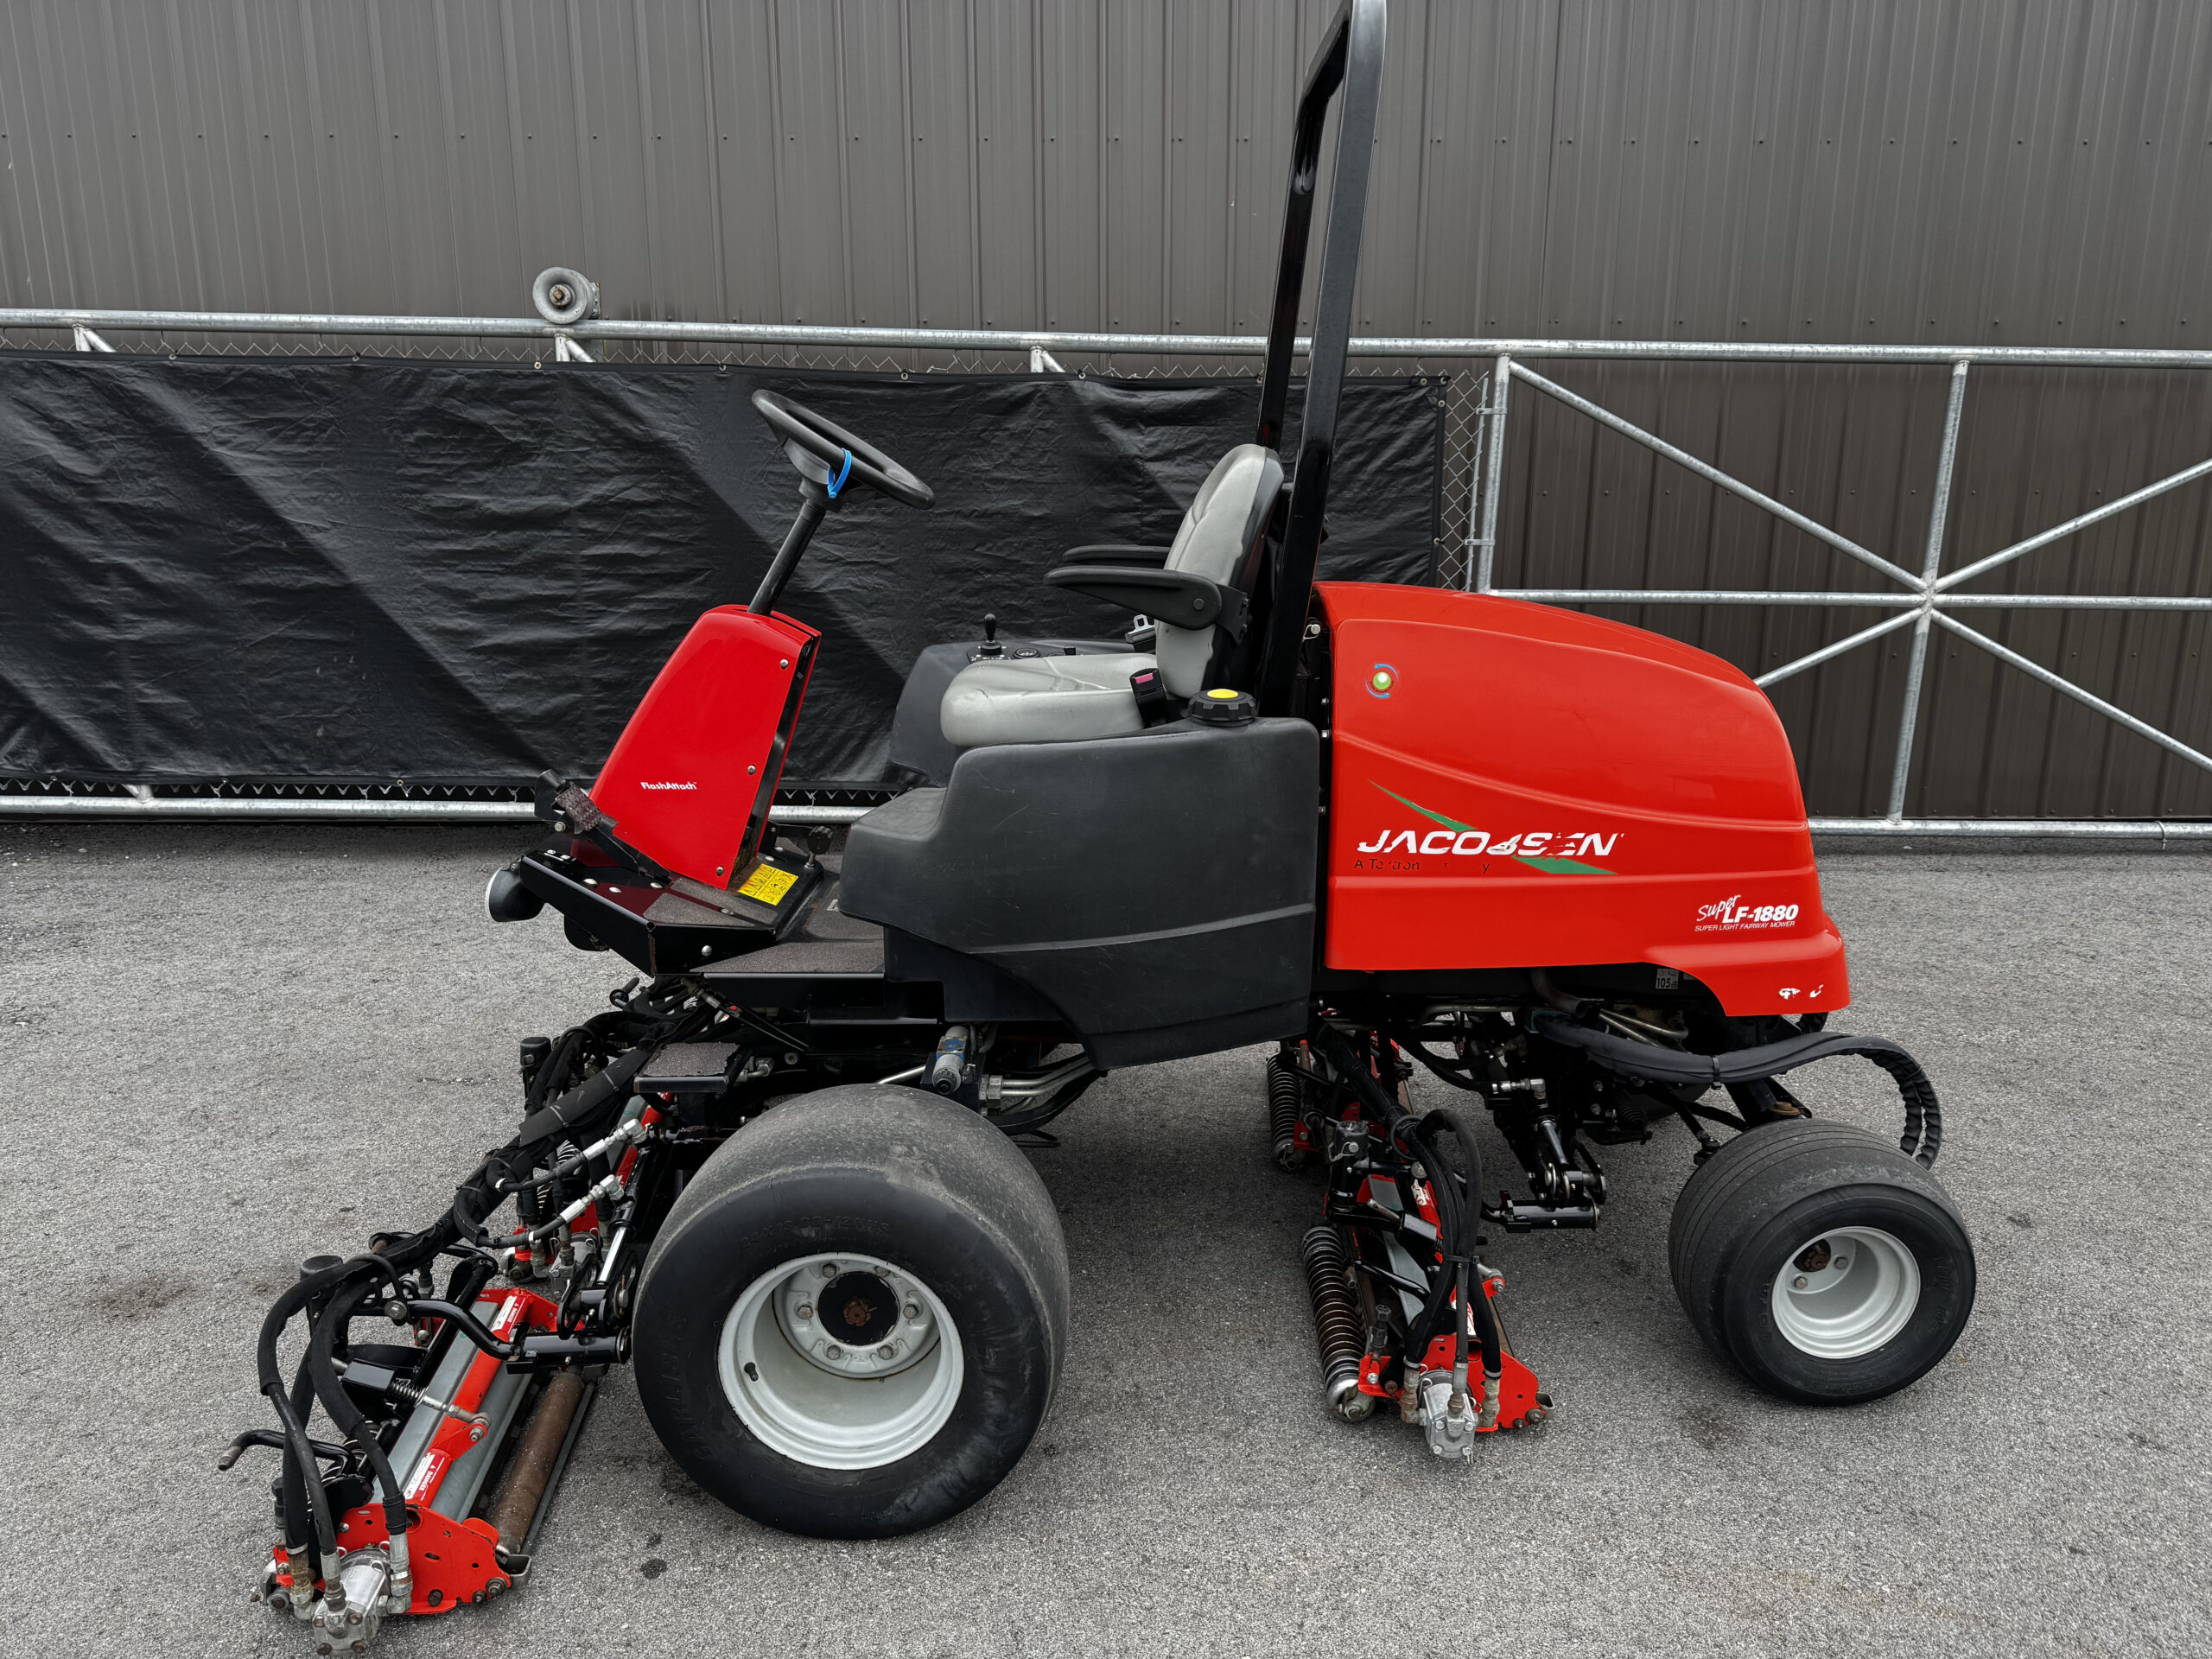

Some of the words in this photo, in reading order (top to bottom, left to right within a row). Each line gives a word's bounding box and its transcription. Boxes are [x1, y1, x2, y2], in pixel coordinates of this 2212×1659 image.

[1354, 859, 1363, 868] A
[1696, 894, 1741, 922] Super
[1722, 904, 1799, 923] LF-1880
[1656, 977, 1671, 988] 105
